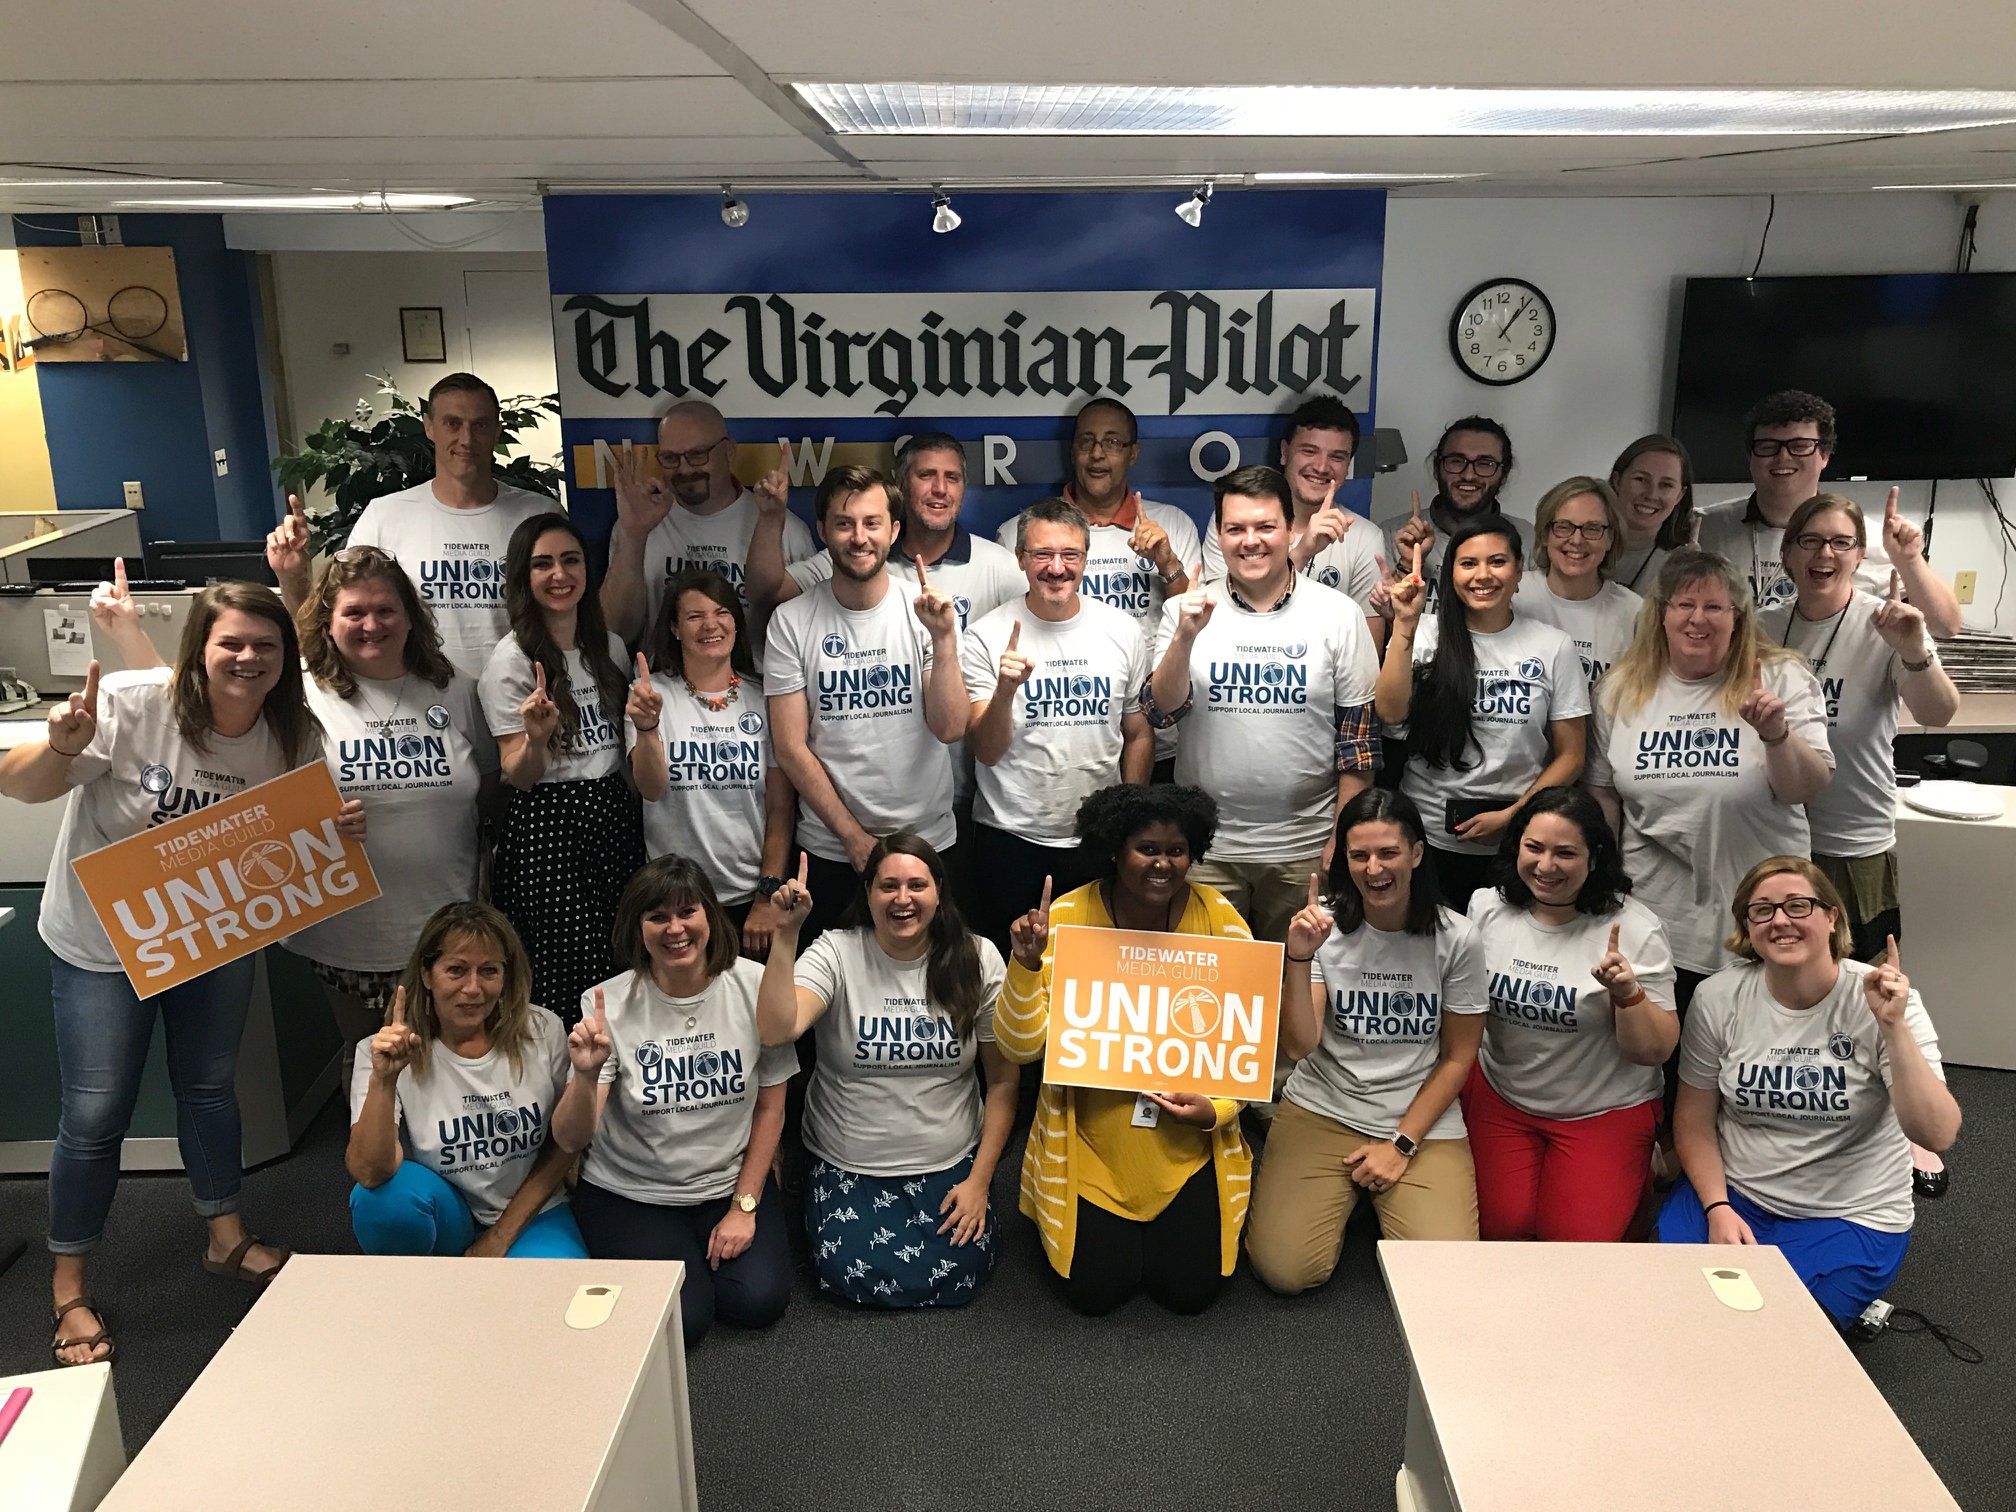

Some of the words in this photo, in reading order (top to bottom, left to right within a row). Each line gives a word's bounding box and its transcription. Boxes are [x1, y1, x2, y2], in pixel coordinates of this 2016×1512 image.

[1483, 299, 1492, 310] 11
[1496, 292, 1510, 304] 12
[1520, 297, 1524, 307] 1
[1469, 314, 1483, 325] 10
[1529, 309, 1538, 320] 2
[1465, 328, 1474, 339] 9
[1534, 325, 1542, 336] 3
[562, 294, 732, 398] The
[724, 290, 1362, 417] Virginian-Pilot
[1471, 343, 1480, 354] 8
[1528, 341, 1536, 351] 4
[1483, 356, 1492, 366] 7
[1498, 361, 1507, 372] 6
[1516, 355, 1525, 365] 5
[1082, 572, 1150, 595] NION
[844, 649, 886, 659] TIDEWATER
[818, 664, 911, 693] UNION
[1210, 662, 1306, 686] UNION
[1024, 675, 1110, 701] UNION
[1209, 685, 1306, 704] STRONG
[820, 687, 912, 711] STRONG
[1025, 699, 1109, 719] STRONG
[872, 708, 912, 718] JOURNALISM
[340, 735, 447, 763] UNION
[1640, 727, 1740, 752] UNION
[670, 740, 759, 764] UNION
[1635, 750, 1739, 770] STRONG
[194, 769, 246, 785] TIDEWATER
[340, 759, 451, 782] STRONG
[668, 763, 760, 781] STRONG
[1692, 770, 1738, 778] JOURNALISM
[191, 778, 219, 787] MEDIA
[404, 781, 453, 790] JOURNALISM
[154, 804, 269, 858] TIDEWATER
[160, 841, 220, 873] MEDIA
[223, 818, 276, 848] GUILD
[112, 818, 345, 940] UNION
[136, 860, 359, 978] STRONG
[1119, 945, 1218, 967] TIDEWATER
[1513, 959, 1558, 973] TIDEWATER
[1117, 960, 1167, 977] MEDIA
[1171, 963, 1219, 982] GUILD
[1362, 973, 1413, 981] TIDEWATER
[1508, 966, 1532, 976] MEDIA
[1534, 971, 1557, 980] GUILD
[1361, 980, 1387, 988] MEDIA
[1389, 981, 1413, 989] GUILD
[884, 1006, 908, 1014] MEDIA
[1063, 978, 1264, 1044] UNION
[1336, 990, 1437, 1017] UNION
[1489, 997, 1577, 1027] TRONG
[859, 1015, 959, 1041] UNION
[1335, 1014, 1436, 1035] STRONG
[1509, 1019, 1531, 1029] LOCAL
[666, 1033, 715, 1046] TIDEWATER
[666, 1045, 691, 1054] MEDIA
[693, 1041, 716, 1050] GUILD
[854, 1041, 960, 1061] STRONG
[1058, 1029, 1259, 1083] STRONG
[642, 1049, 743, 1085] UNION
[915, 1061, 960, 1069] JOURNALISM
[1738, 1063, 1847, 1090] UNION
[642, 1074, 745, 1106] STRONG
[1735, 1088, 1849, 1111] STRONG
[641, 1108, 675, 1116] SUPPORT
[700, 1096, 745, 1110] JOURNALISM
[438, 1102, 542, 1145] UNION
[440, 1127, 542, 1165] STRONG
[440, 1165, 474, 1176] SUPPORT
[475, 1162, 499, 1170] LOCAL
